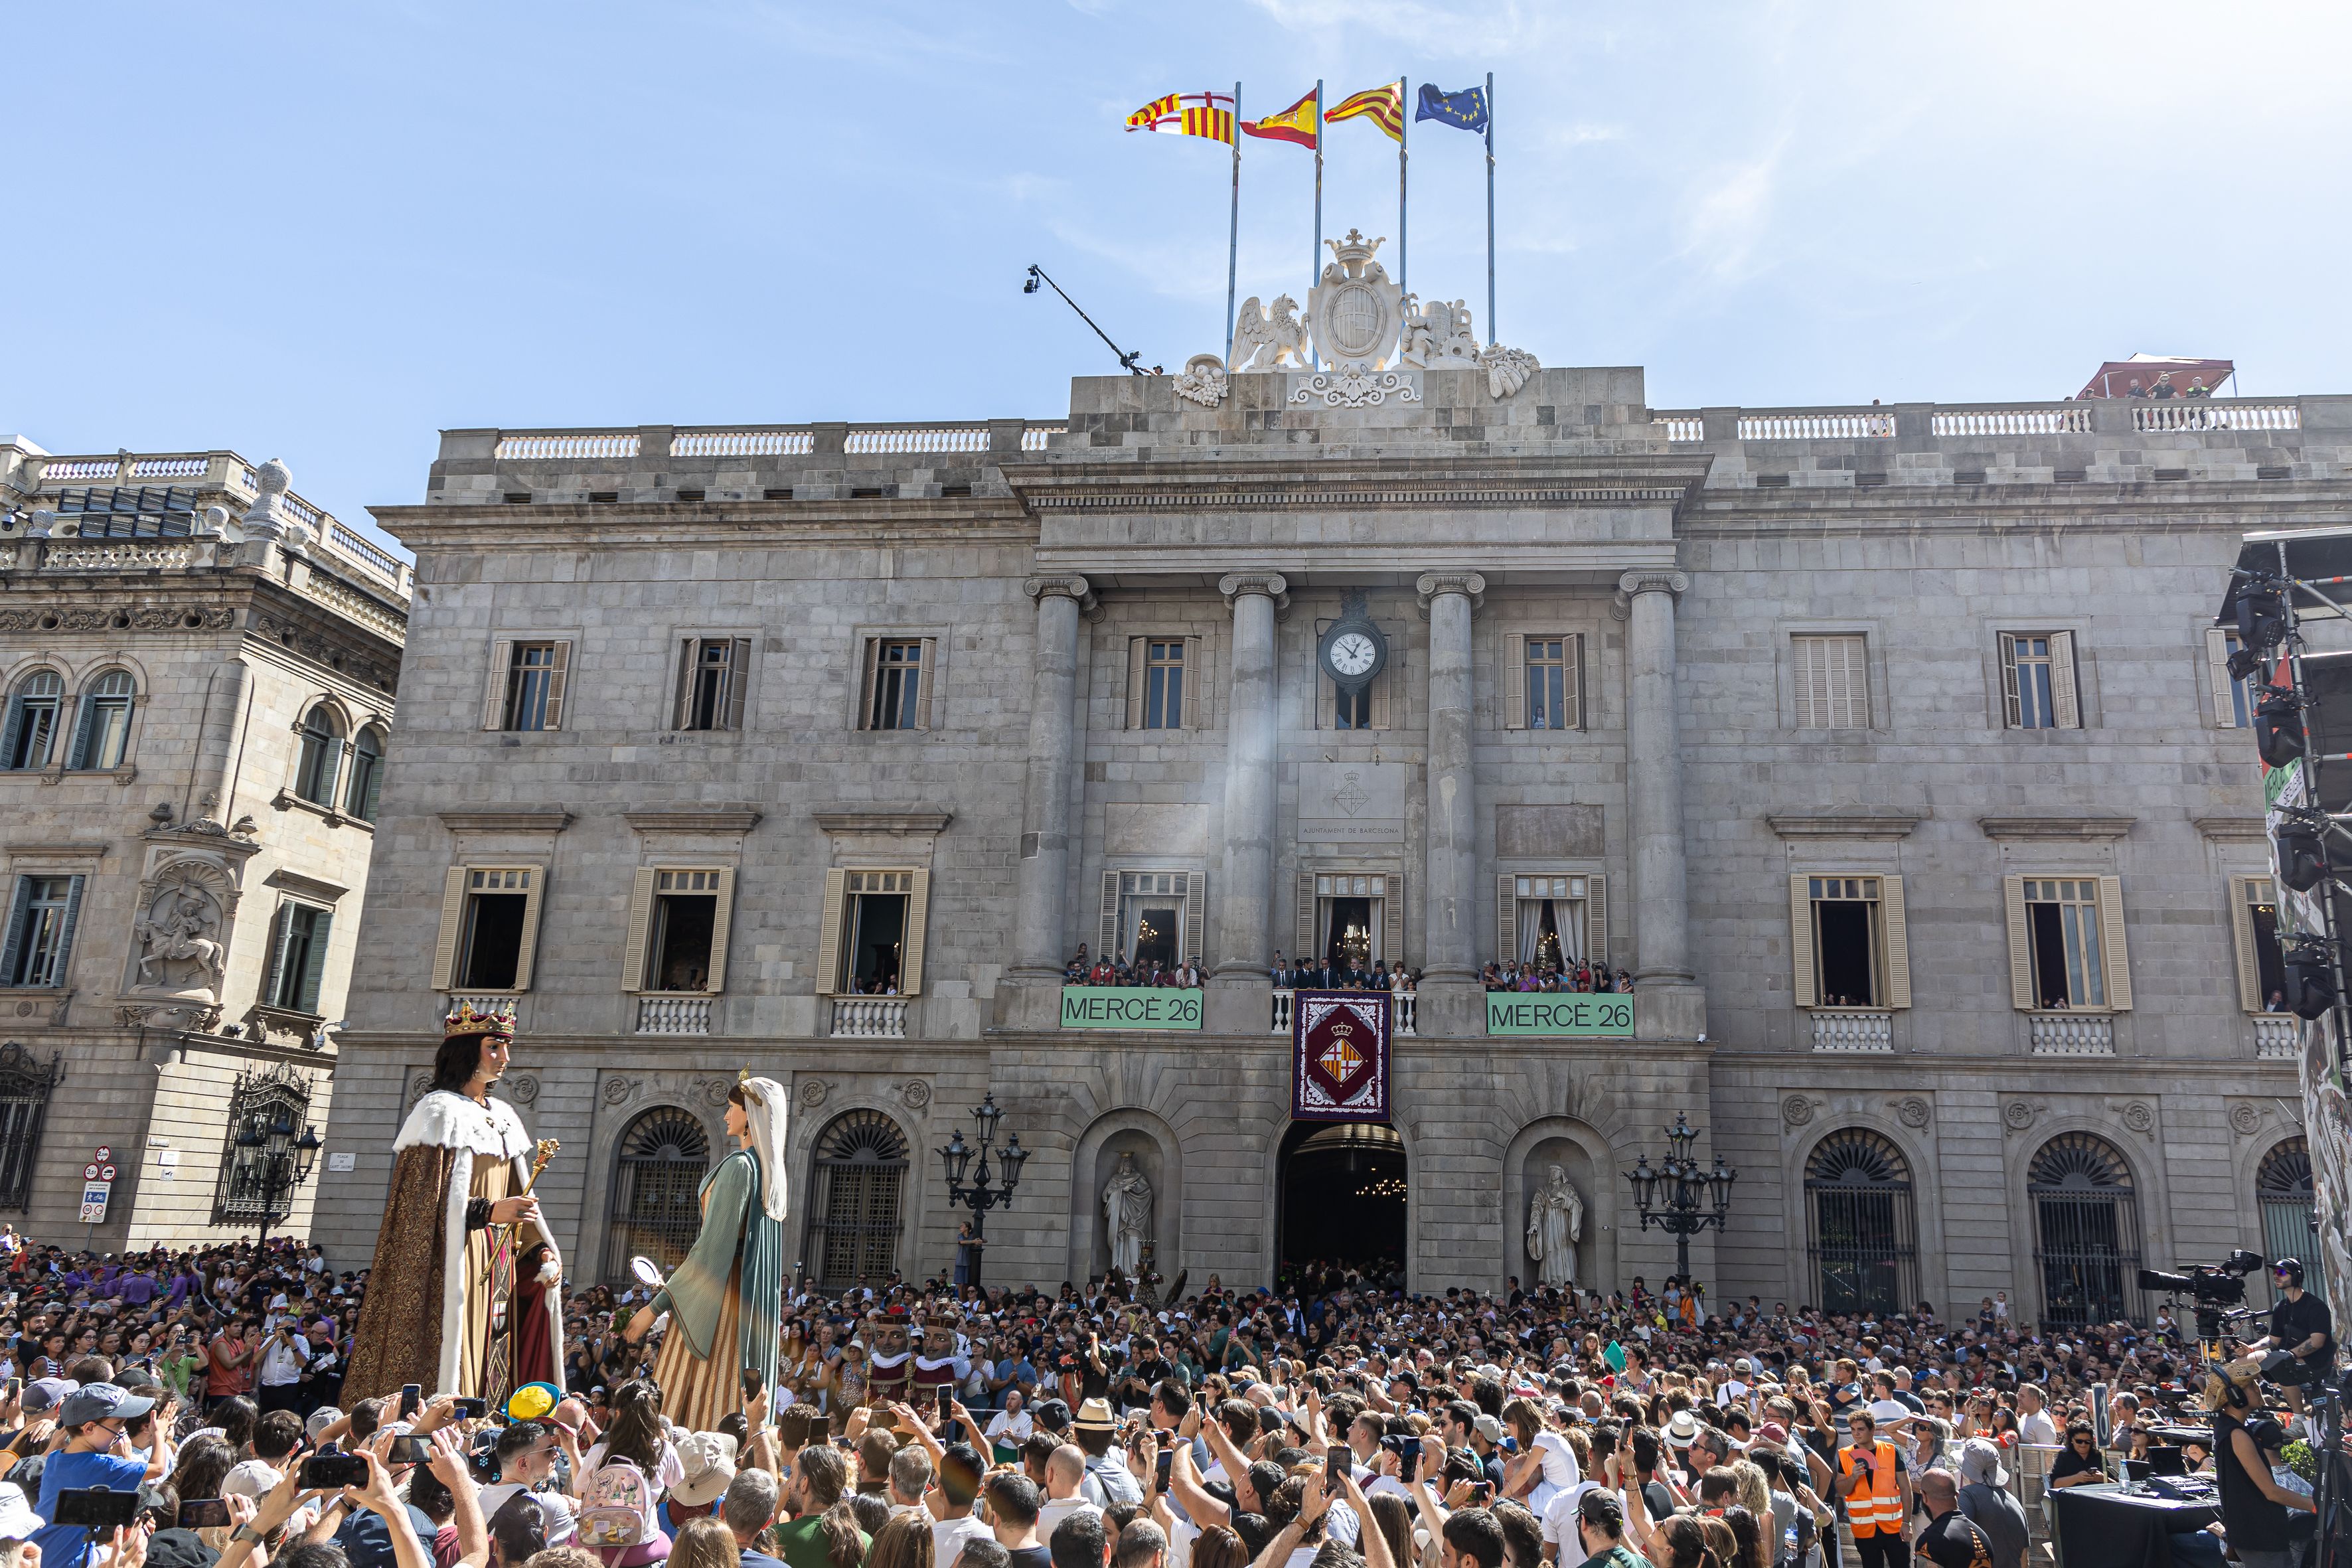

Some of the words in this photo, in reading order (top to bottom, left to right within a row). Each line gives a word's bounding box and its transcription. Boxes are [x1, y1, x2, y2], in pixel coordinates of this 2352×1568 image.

[1065, 996, 1162, 1021] MERCÈ
[1168, 999, 1198, 1021] 26
[1492, 1002, 1592, 1027] MERCÈ
[1598, 1004, 1630, 1027] 26
